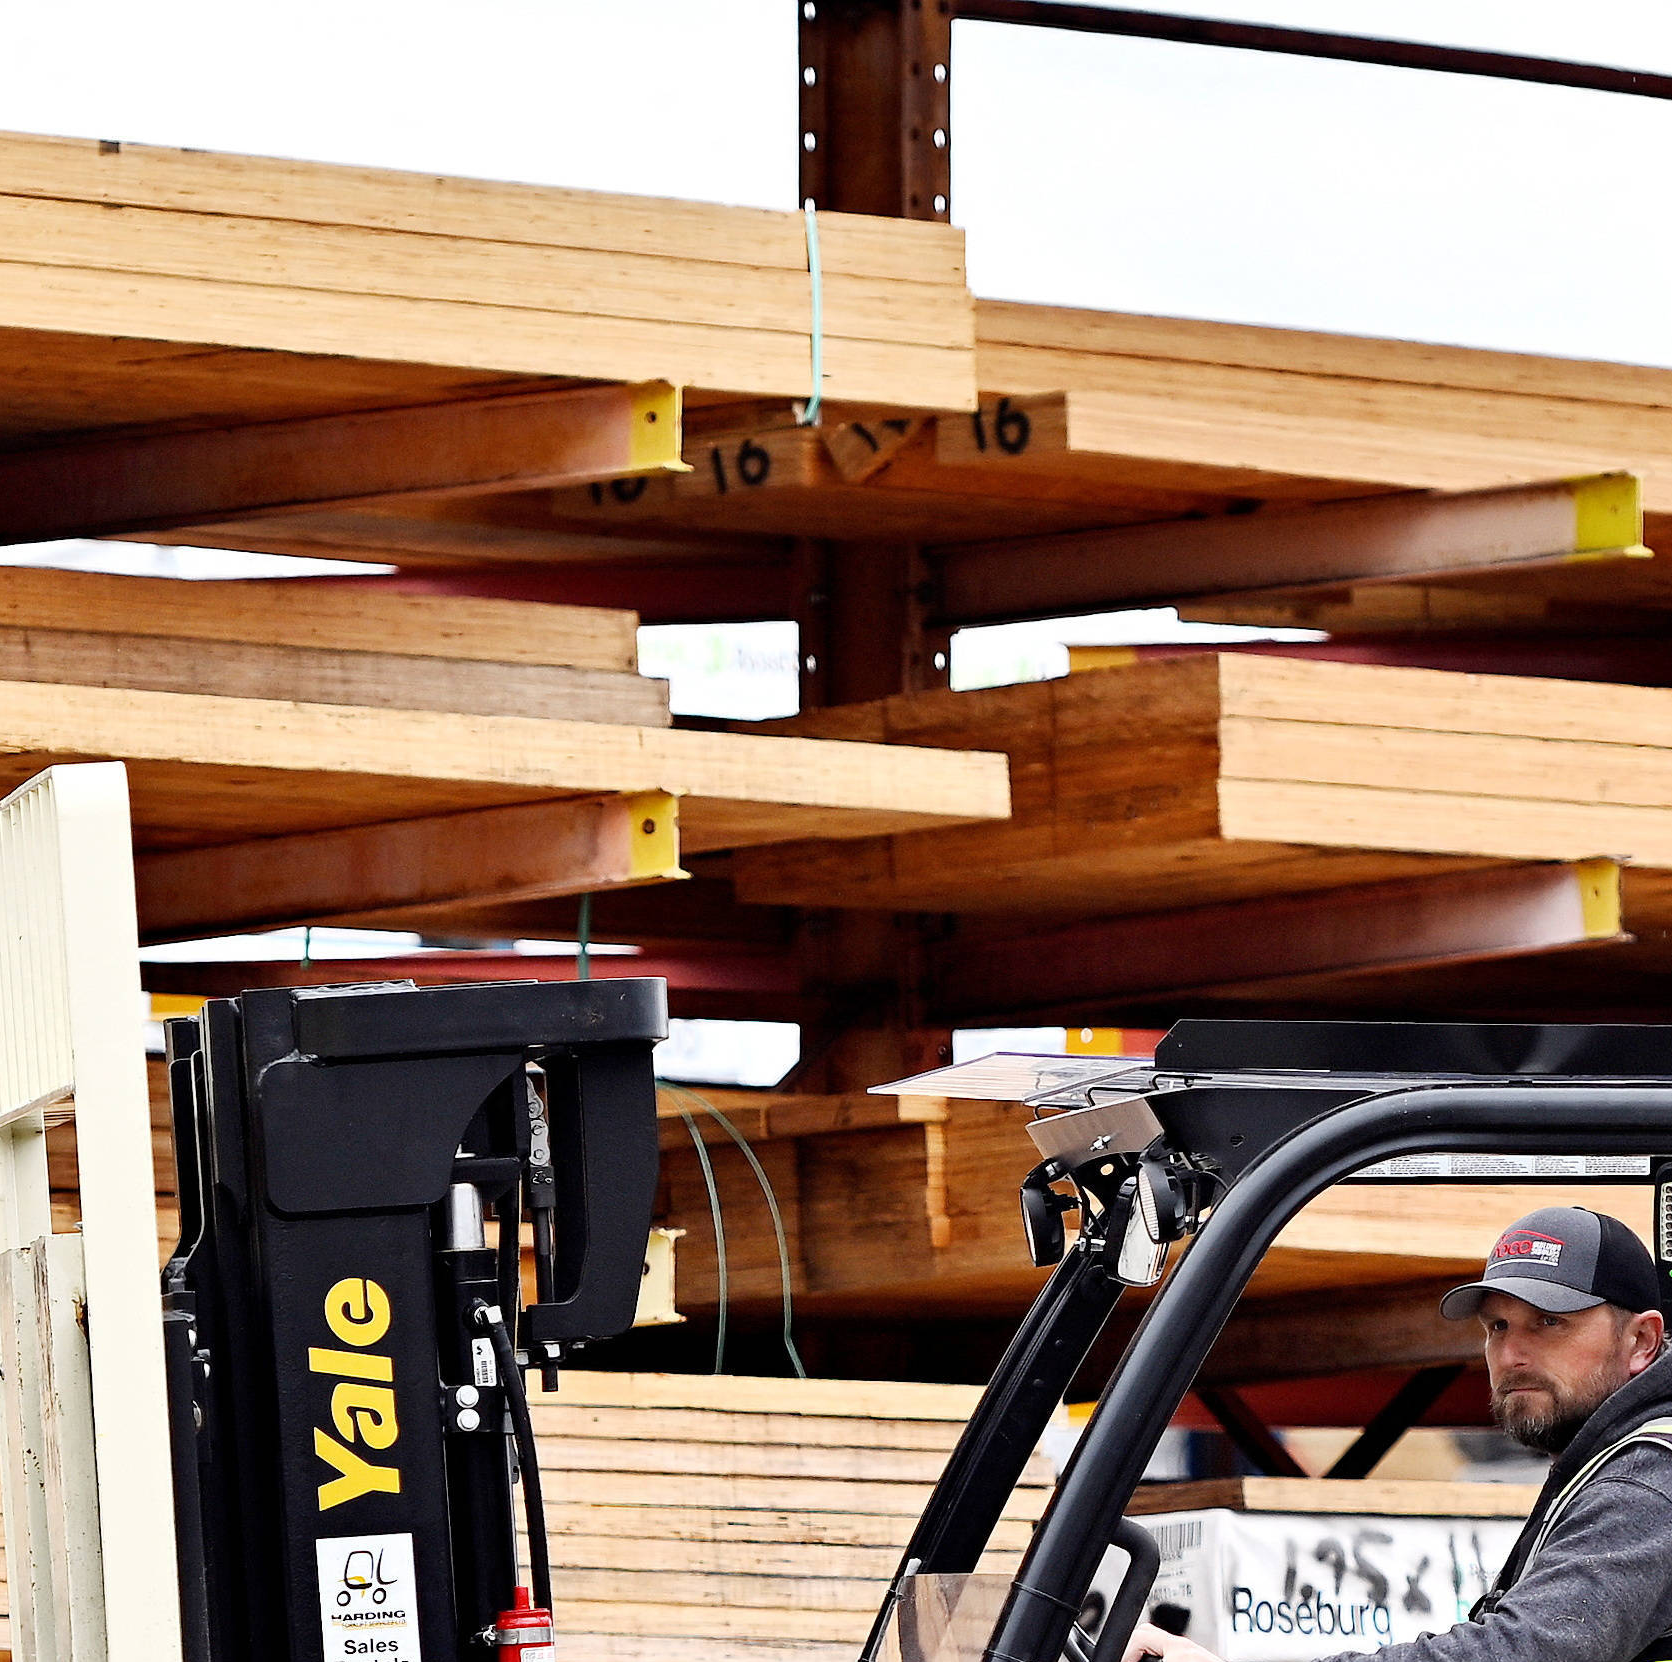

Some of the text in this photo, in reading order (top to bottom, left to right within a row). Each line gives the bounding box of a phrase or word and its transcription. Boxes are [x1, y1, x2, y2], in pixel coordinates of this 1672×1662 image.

[711, 438, 770, 495] 16
[308, 1276, 402, 1512] Yale
[1232, 1586, 1393, 1646] Roseburg
[344, 1638, 399, 1655] Sales
